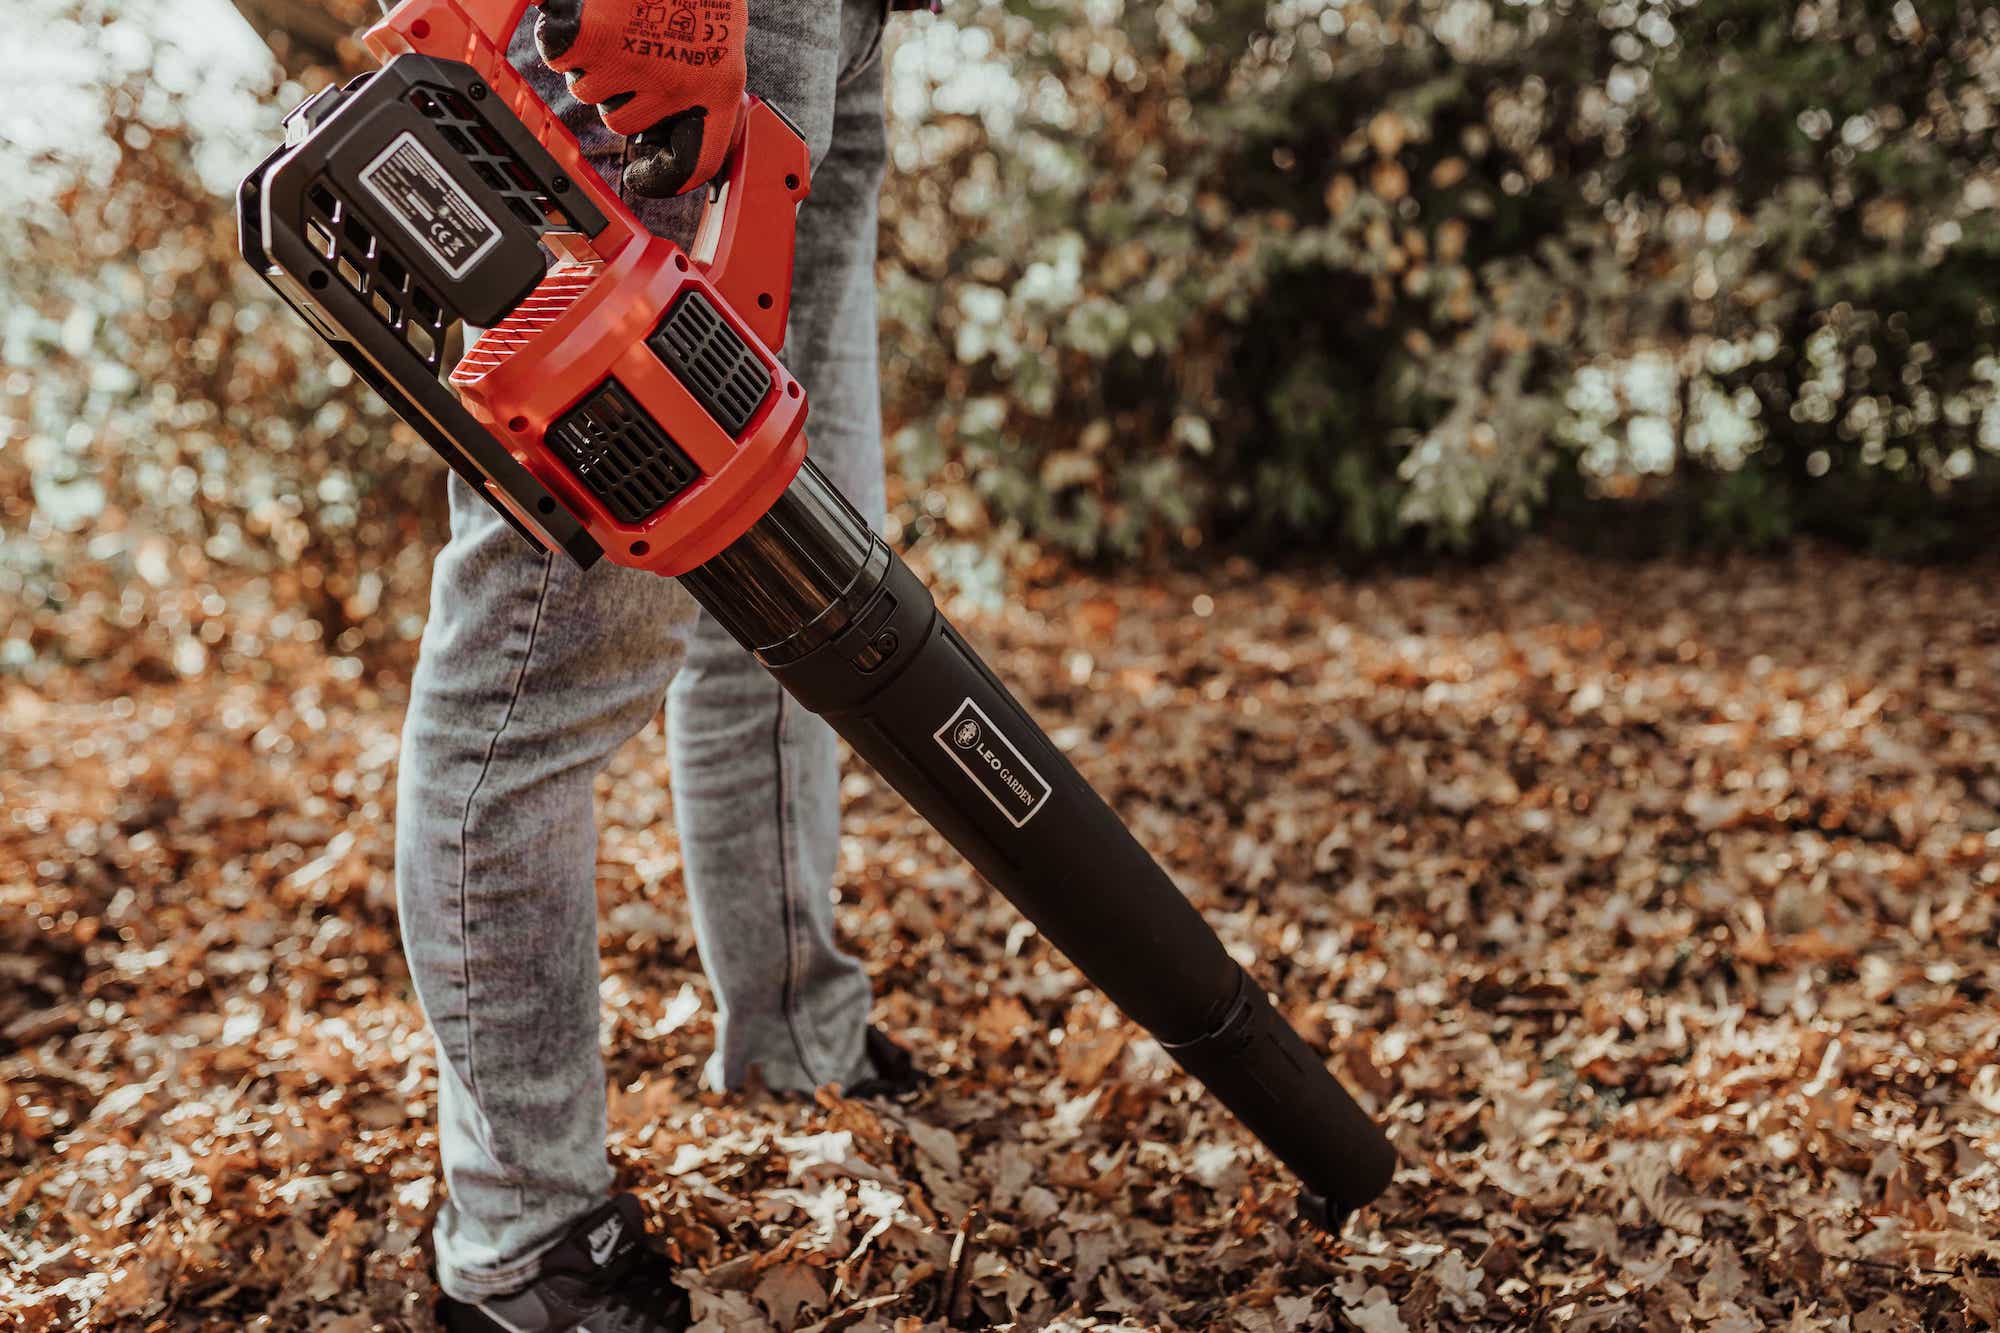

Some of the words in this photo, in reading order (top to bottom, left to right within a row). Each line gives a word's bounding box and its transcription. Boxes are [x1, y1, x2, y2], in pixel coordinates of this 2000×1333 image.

[621, 37, 706, 66] GNYLEX
[976, 742, 1002, 770] LEO
[1000, 768, 1035, 806] GARDEN
